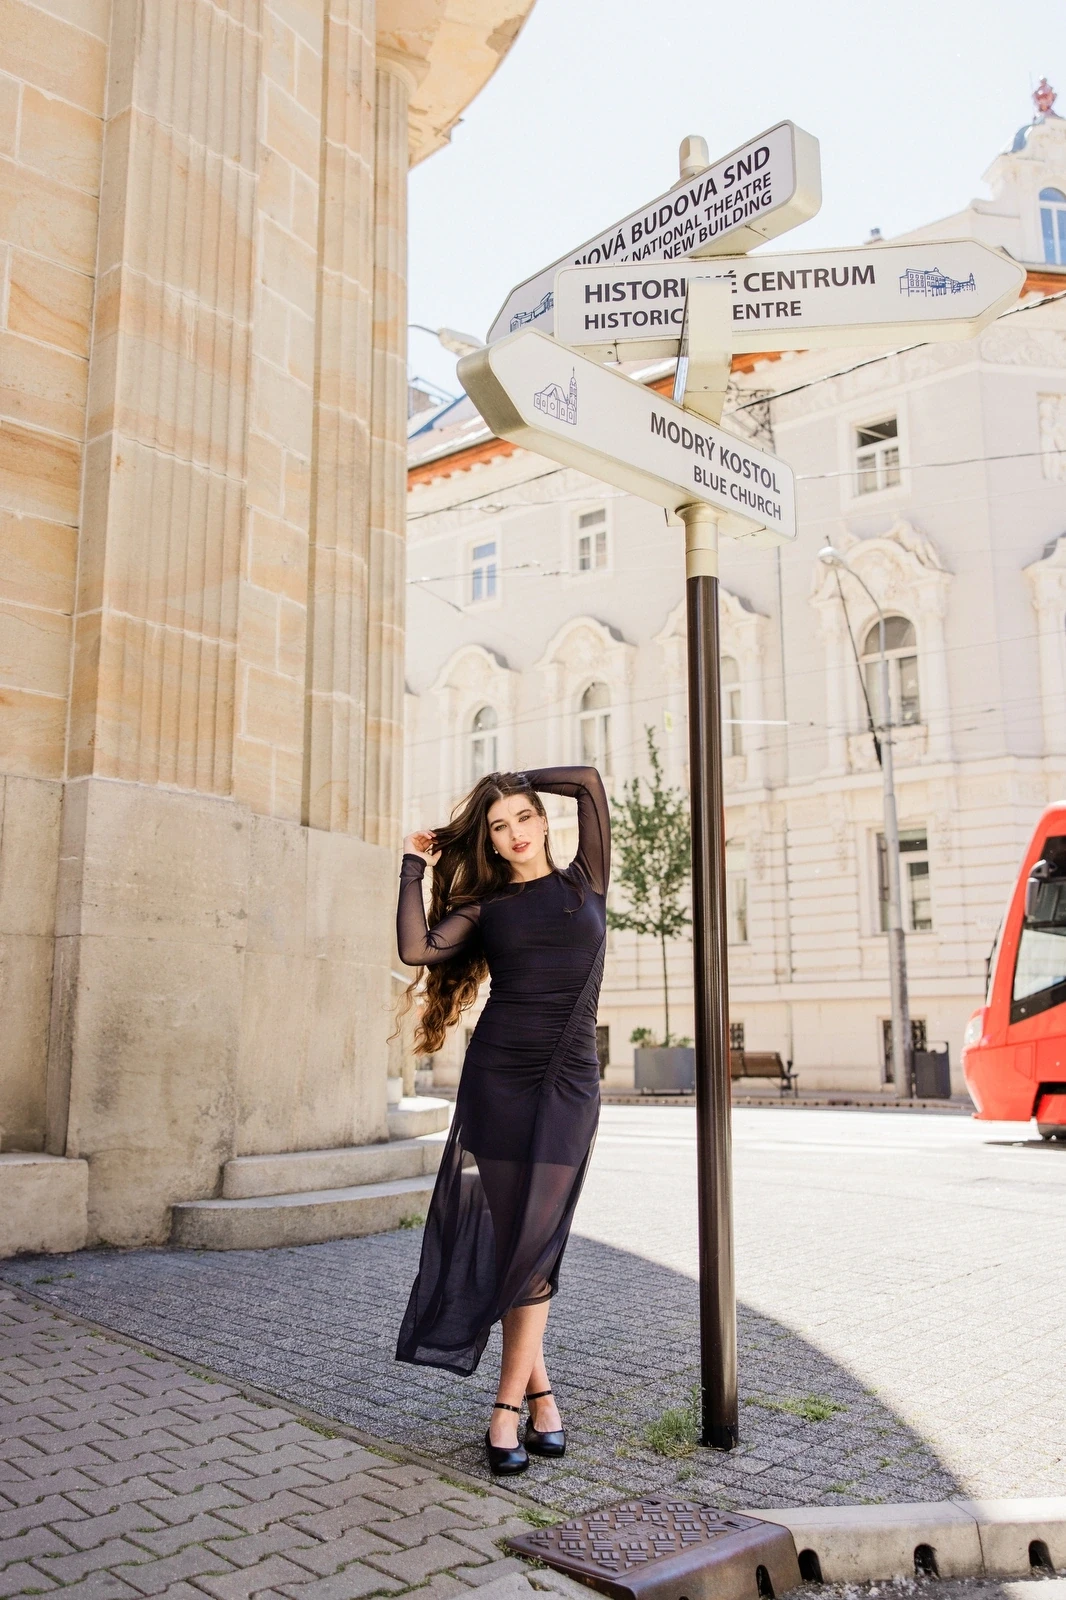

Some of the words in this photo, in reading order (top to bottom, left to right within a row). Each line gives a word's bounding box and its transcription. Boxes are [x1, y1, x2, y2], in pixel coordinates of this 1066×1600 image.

[631, 177, 718, 245] BUDOVA
[723, 146, 770, 189] SND
[632, 214, 702, 262] NATIONAL
[704, 171, 772, 221] THEATRE
[663, 232, 695, 260] NEW
[699, 190, 772, 244] BUILDING
[743, 264, 876, 293] CENTRUM
[584, 307, 684, 330] HISTORIC
[732, 300, 802, 320] ENTRE
[651, 411, 715, 461] MODRÝ
[719, 446, 781, 494] KOSTOL
[693, 464, 727, 496] BLUE
[730, 483, 782, 521] CHURCH
